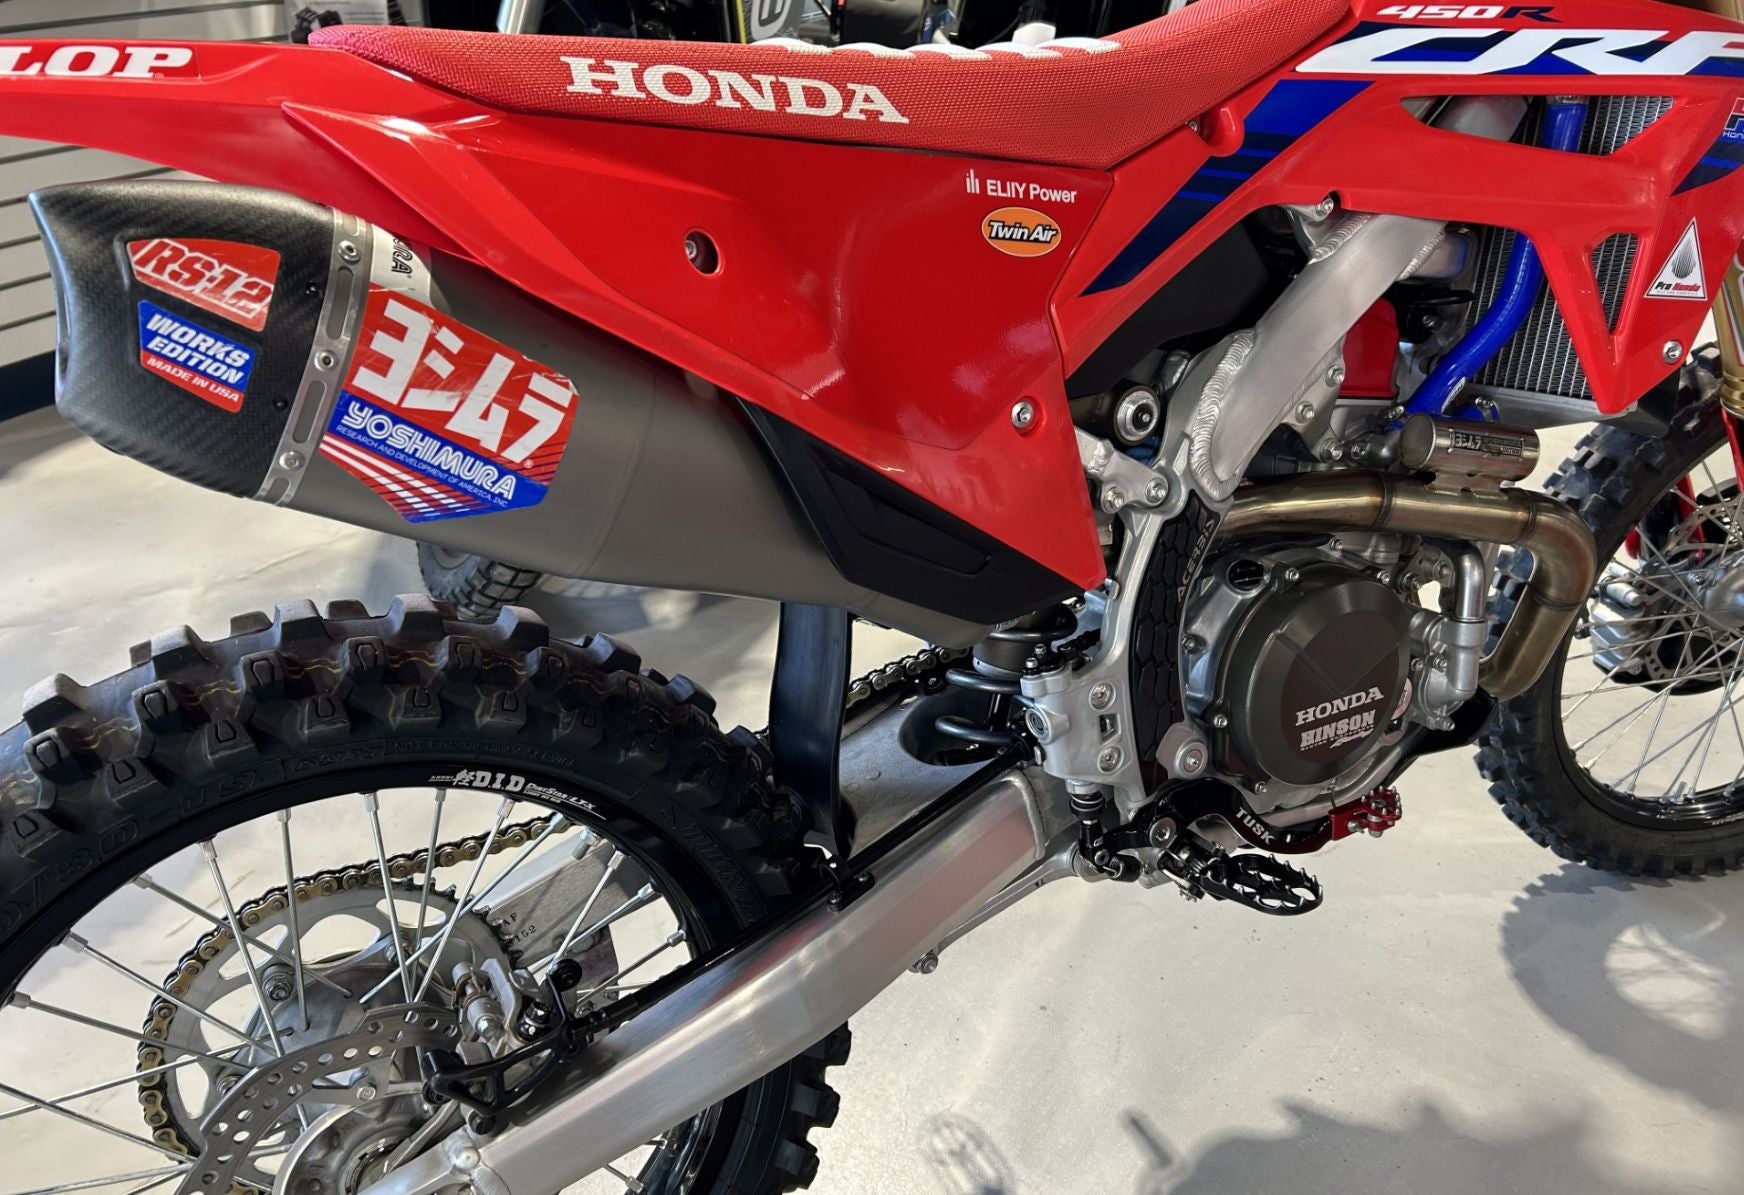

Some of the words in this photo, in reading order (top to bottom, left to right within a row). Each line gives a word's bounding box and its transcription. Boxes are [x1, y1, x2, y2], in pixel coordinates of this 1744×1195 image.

[1377, 4, 1562, 23] 450R
[0, 45, 192, 78] LOP
[559, 55, 910, 125] HONDA
[1029, 183, 1077, 203] Power
[1655, 281, 1672, 290] Pro
[146, 313, 250, 367] WORKS
[147, 336, 244, 384] EDITION
[147, 357, 193, 381] MADE
[192, 376, 209, 388] IN
[209, 384, 240, 402] USA
[336, 425, 379, 448] RESEARCH
[378, 444, 395, 456] AND
[341, 401, 517, 500] YOSHIMURA
[1295, 686, 1385, 726] HONDA
[1300, 709, 1377, 748] HINSON
[472, 770, 526, 792] D.I.D
[1235, 806, 1276, 845] TUSK
